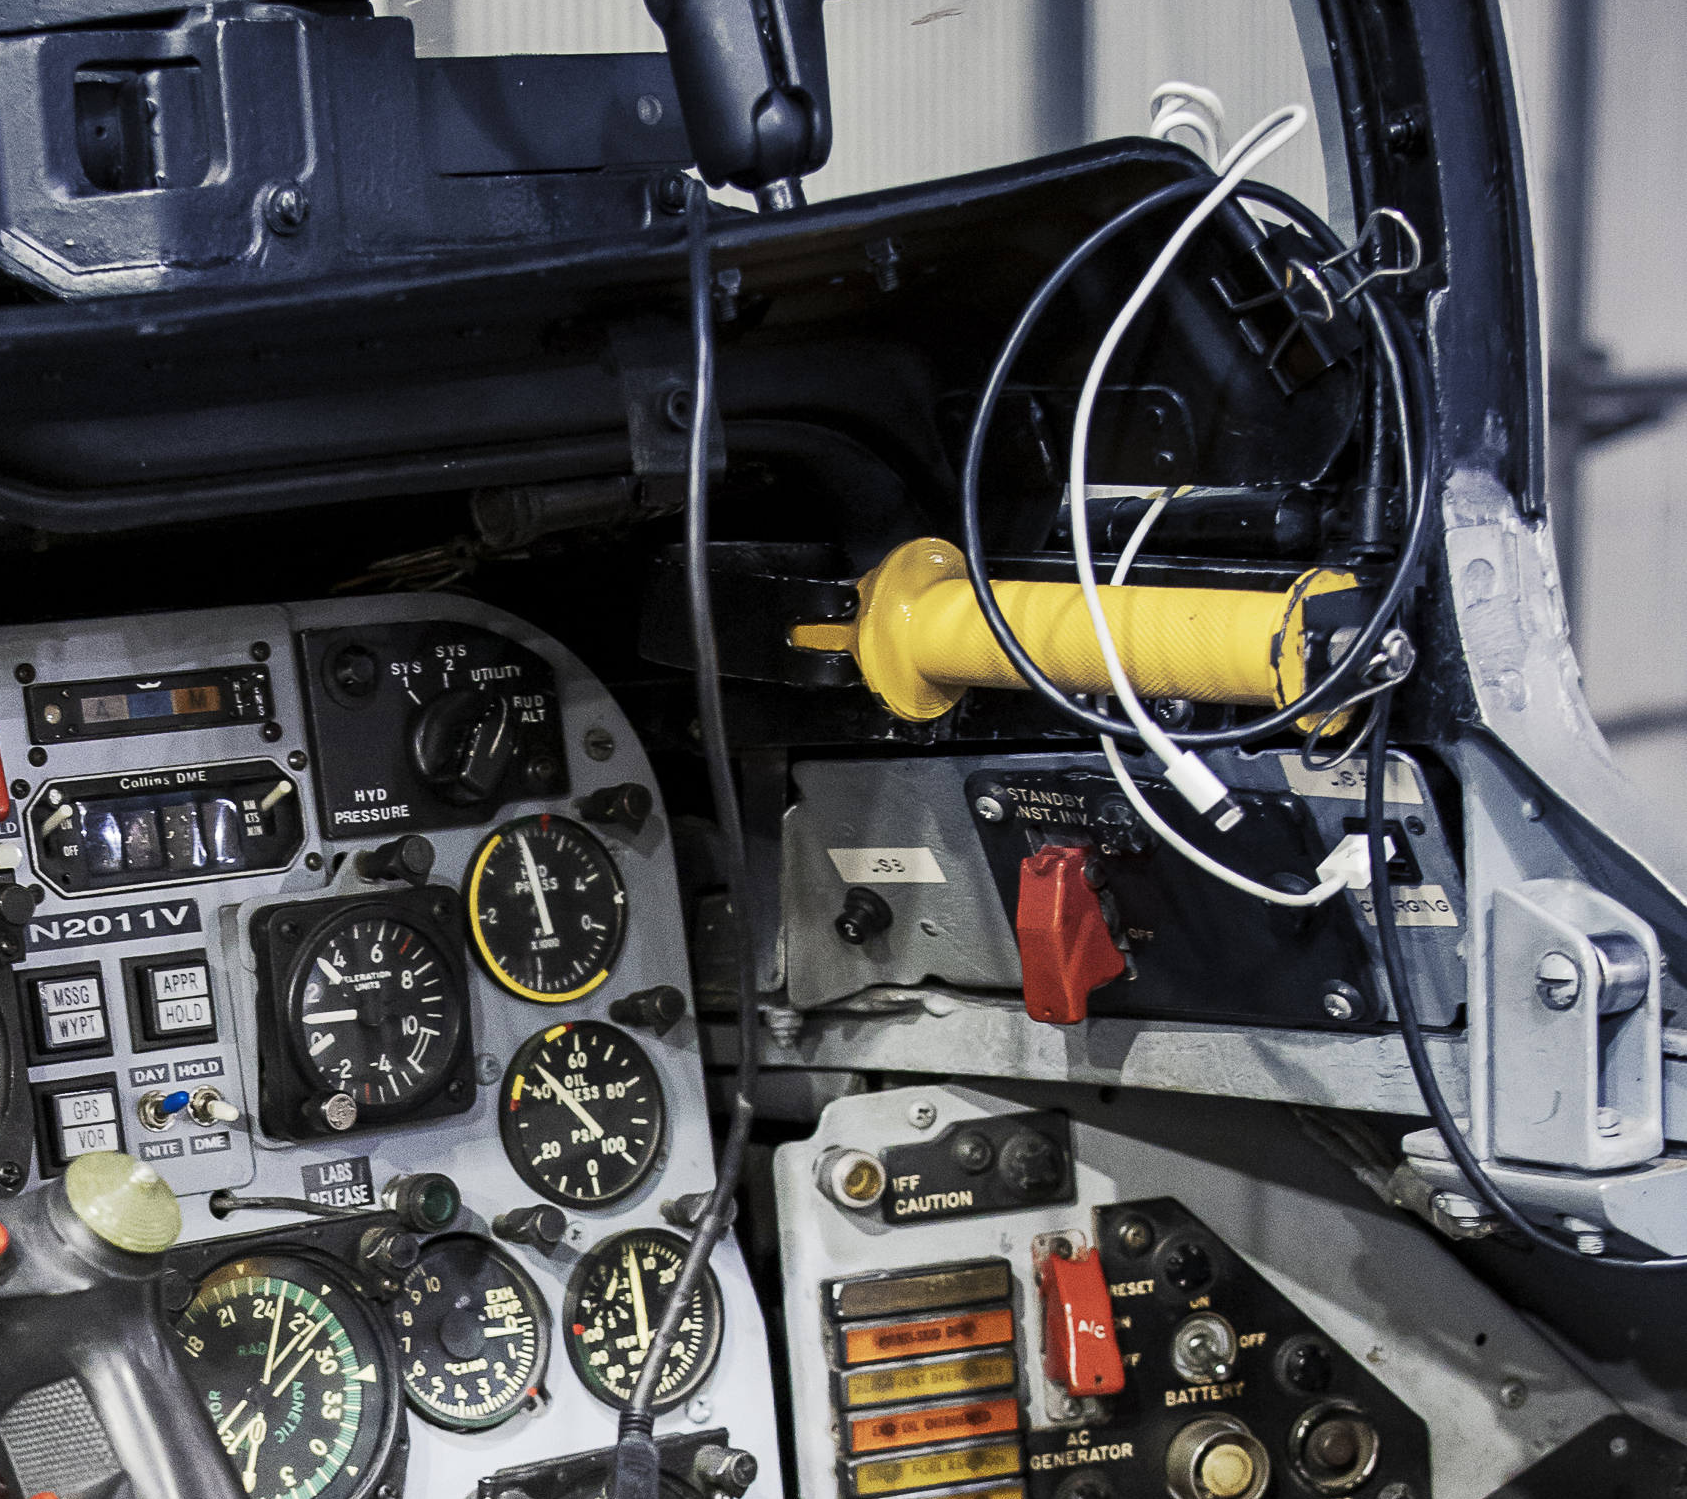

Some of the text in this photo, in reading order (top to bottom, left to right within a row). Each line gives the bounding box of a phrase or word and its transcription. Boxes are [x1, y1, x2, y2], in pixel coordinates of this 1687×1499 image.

[435, 644, 466, 658] SYS
[391, 661, 421, 675] SYS
[471, 665, 521, 682] UTILITY
[513, 695, 544, 709] RUD
[521, 709, 546, 723] ALT
[120, 770, 207, 790] Collins DME
[354, 788, 388, 802] HYD
[1007, 787, 1085, 809] STANDBY
[334, 804, 410, 825] PRESSURE
[29, 905, 188, 943] N2011V
[1128, 927, 1154, 941] OFF
[163, 971, 199, 993] APPR
[53, 985, 90, 1006] MSSG
[166, 1002, 203, 1024] HOLD
[60, 1015, 95, 1037] WYPT
[178, 1061, 219, 1077] HOLD
[567, 1053, 587, 1069] 60
[135, 1067, 165, 1082] DAY
[564, 1074, 588, 1089] OIL
[532, 1084, 552, 1099] 40
[606, 1082, 625, 1099] 80
[73, 1099, 99, 1120] GPS
[77, 1128, 107, 1148] VOR
[194, 1135, 226, 1151] DME
[601, 1137, 627, 1154] 100
[144, 1143, 179, 1158] NITE
[541, 1142, 561, 1158] 20
[320, 1163, 352, 1185] LABS
[893, 1175, 921, 1193] IFF
[895, 1190, 973, 1216] CAUTION
[217, 1305, 236, 1328] 21
[252, 1298, 278, 1319] 24
[483, 1300, 524, 1319] TEMP.
[288, 1312, 315, 1337] 27
[1078, 1320, 1106, 1339] A/C
[184, 1335, 204, 1358] 18
[1239, 1332, 1266, 1349] OFF
[315, 1346, 338, 1376] 30
[1165, 1381, 1245, 1407] BATTERY
[321, 1390, 343, 1420] 33
[1067, 1430, 1091, 1447] AC
[1029, 1442, 1134, 1471] GENERATOR
